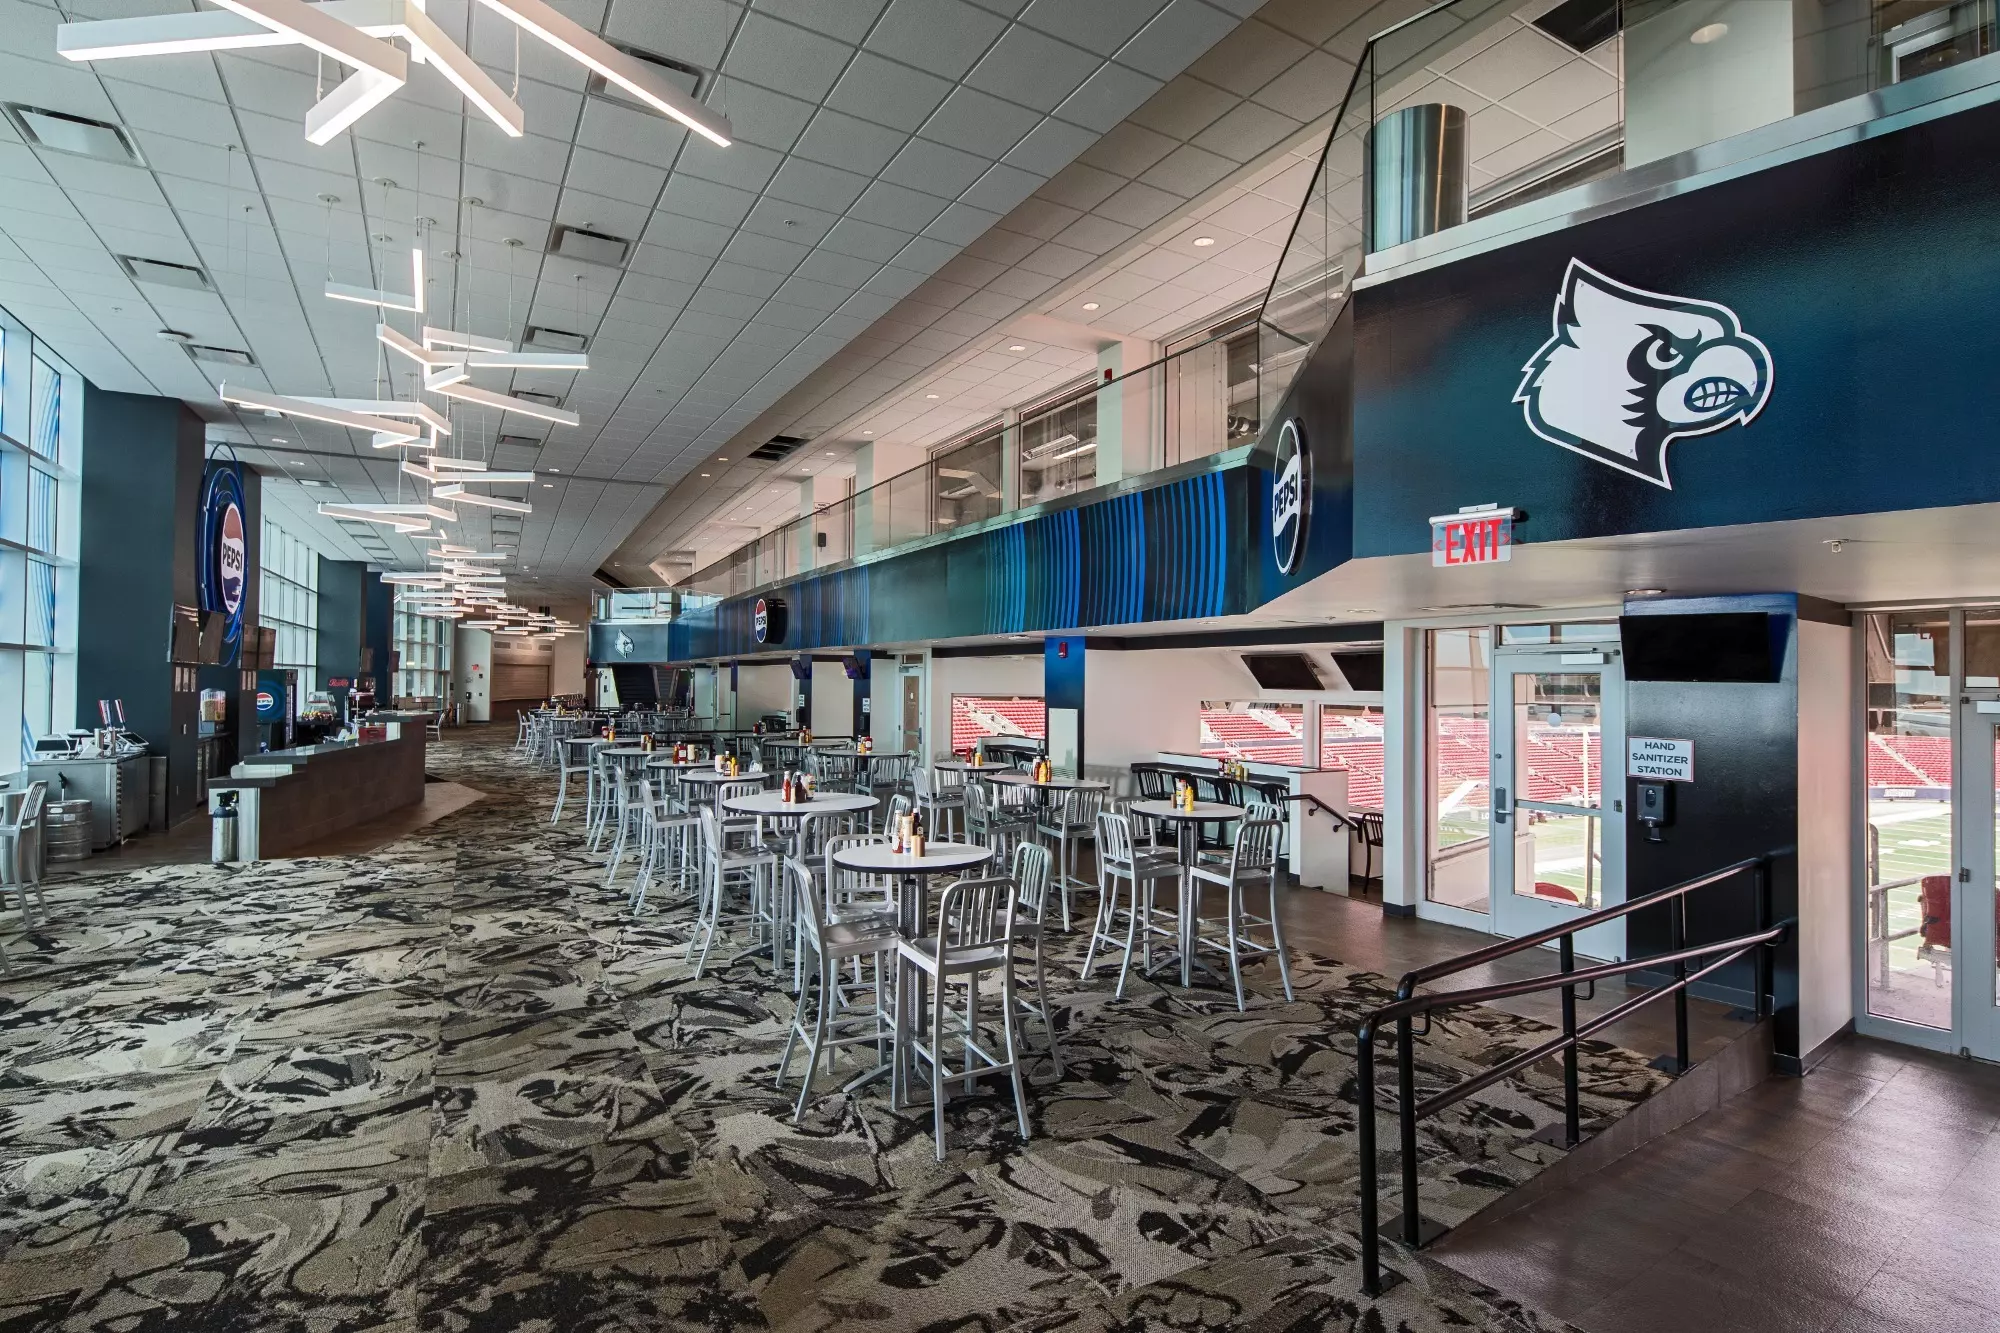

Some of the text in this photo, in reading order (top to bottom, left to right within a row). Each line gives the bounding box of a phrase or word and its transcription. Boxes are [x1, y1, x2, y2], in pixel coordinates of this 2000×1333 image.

[1274, 469, 1298, 522] PEPSI
[1446, 518, 1502, 565] EXIT
[222, 542, 243, 573] PEPSI
[1644, 741, 1676, 751] HAND
[1632, 752, 1689, 765] SANITIZER
[1637, 765, 1682, 777] STATION
